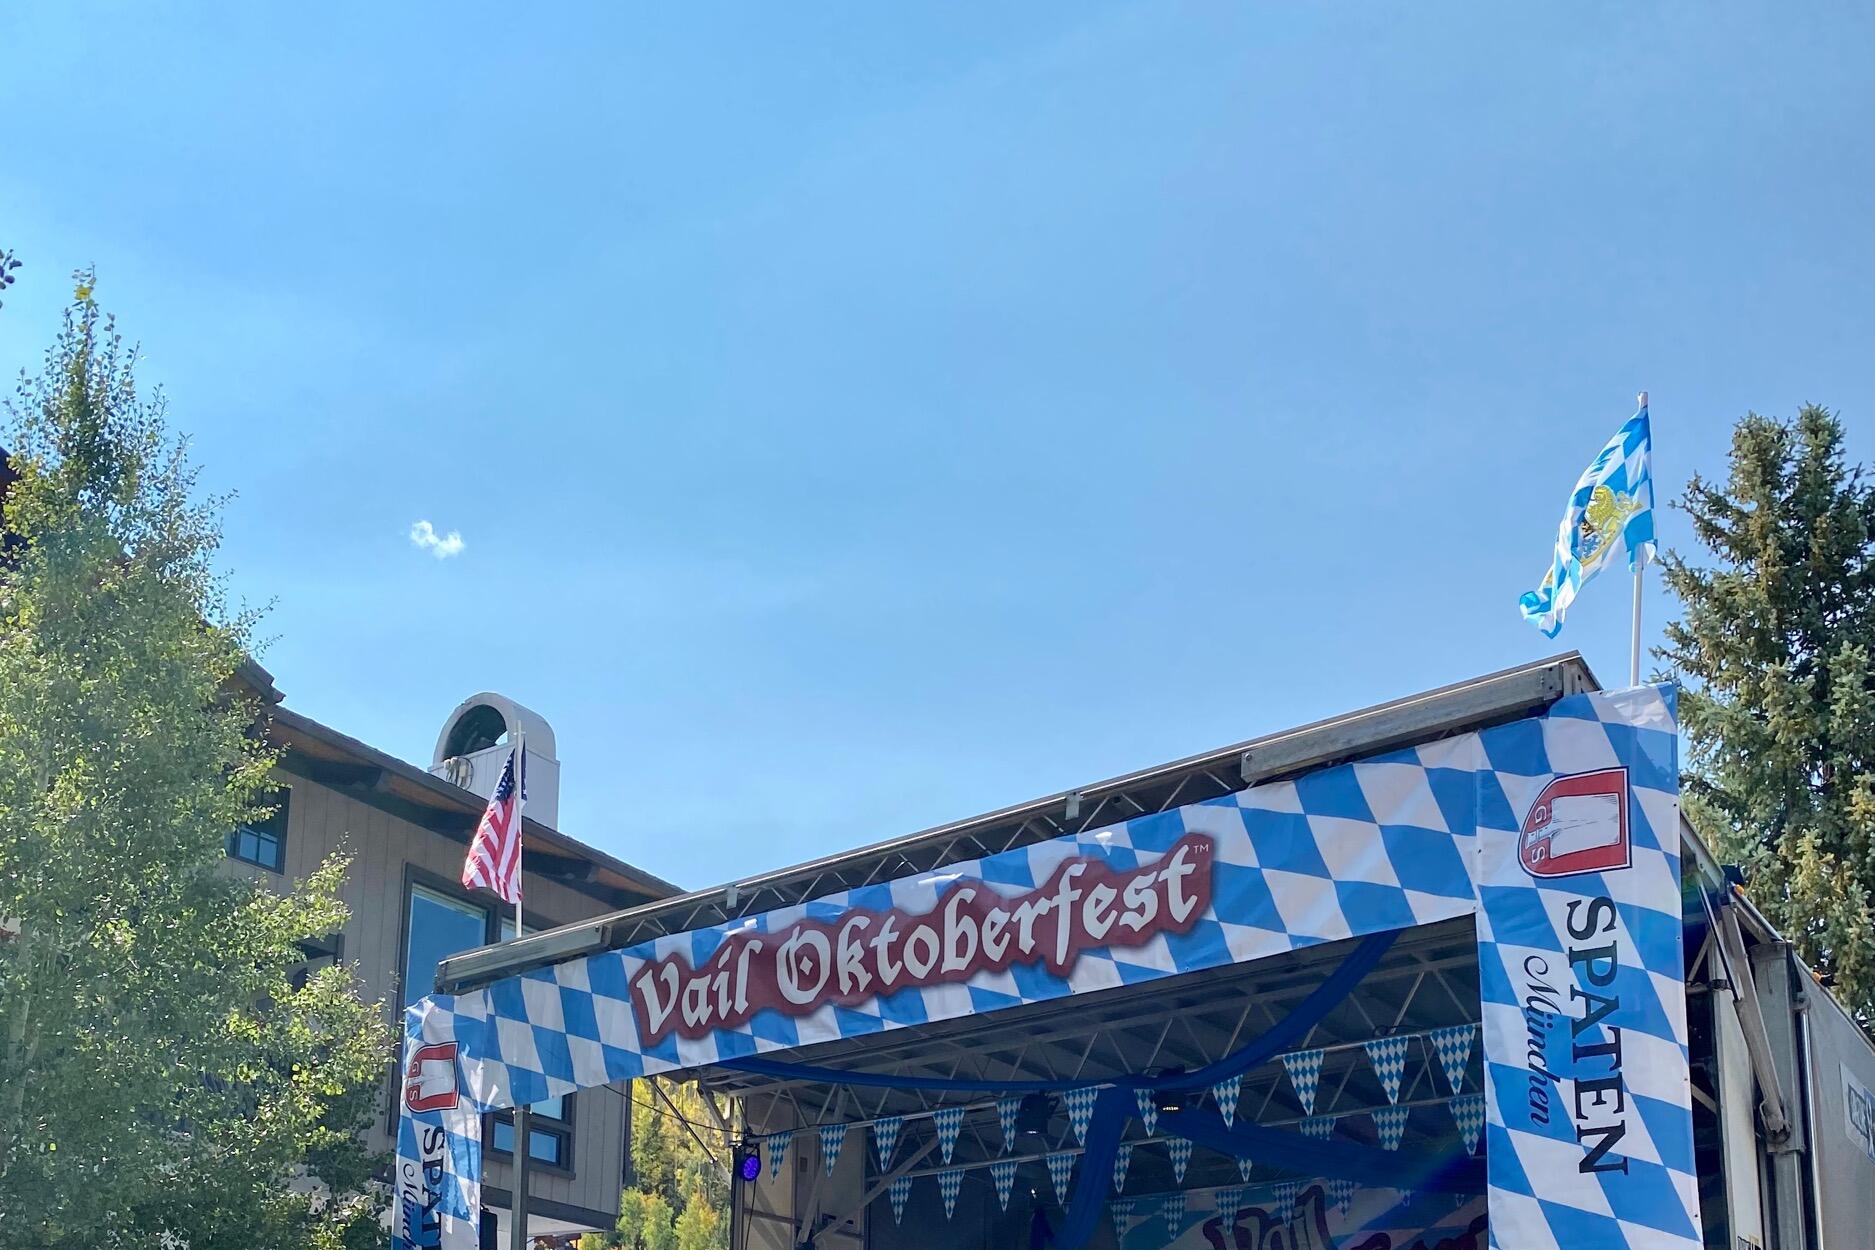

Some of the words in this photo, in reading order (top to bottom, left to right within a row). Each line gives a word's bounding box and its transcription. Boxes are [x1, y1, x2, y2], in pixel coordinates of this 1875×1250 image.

[637, 937, 763, 1036] Vail
[775, 844, 1197, 1003] Oktoberfest
[1566, 896, 1630, 1176] SPATEN
[1522, 954, 1562, 1127] München
